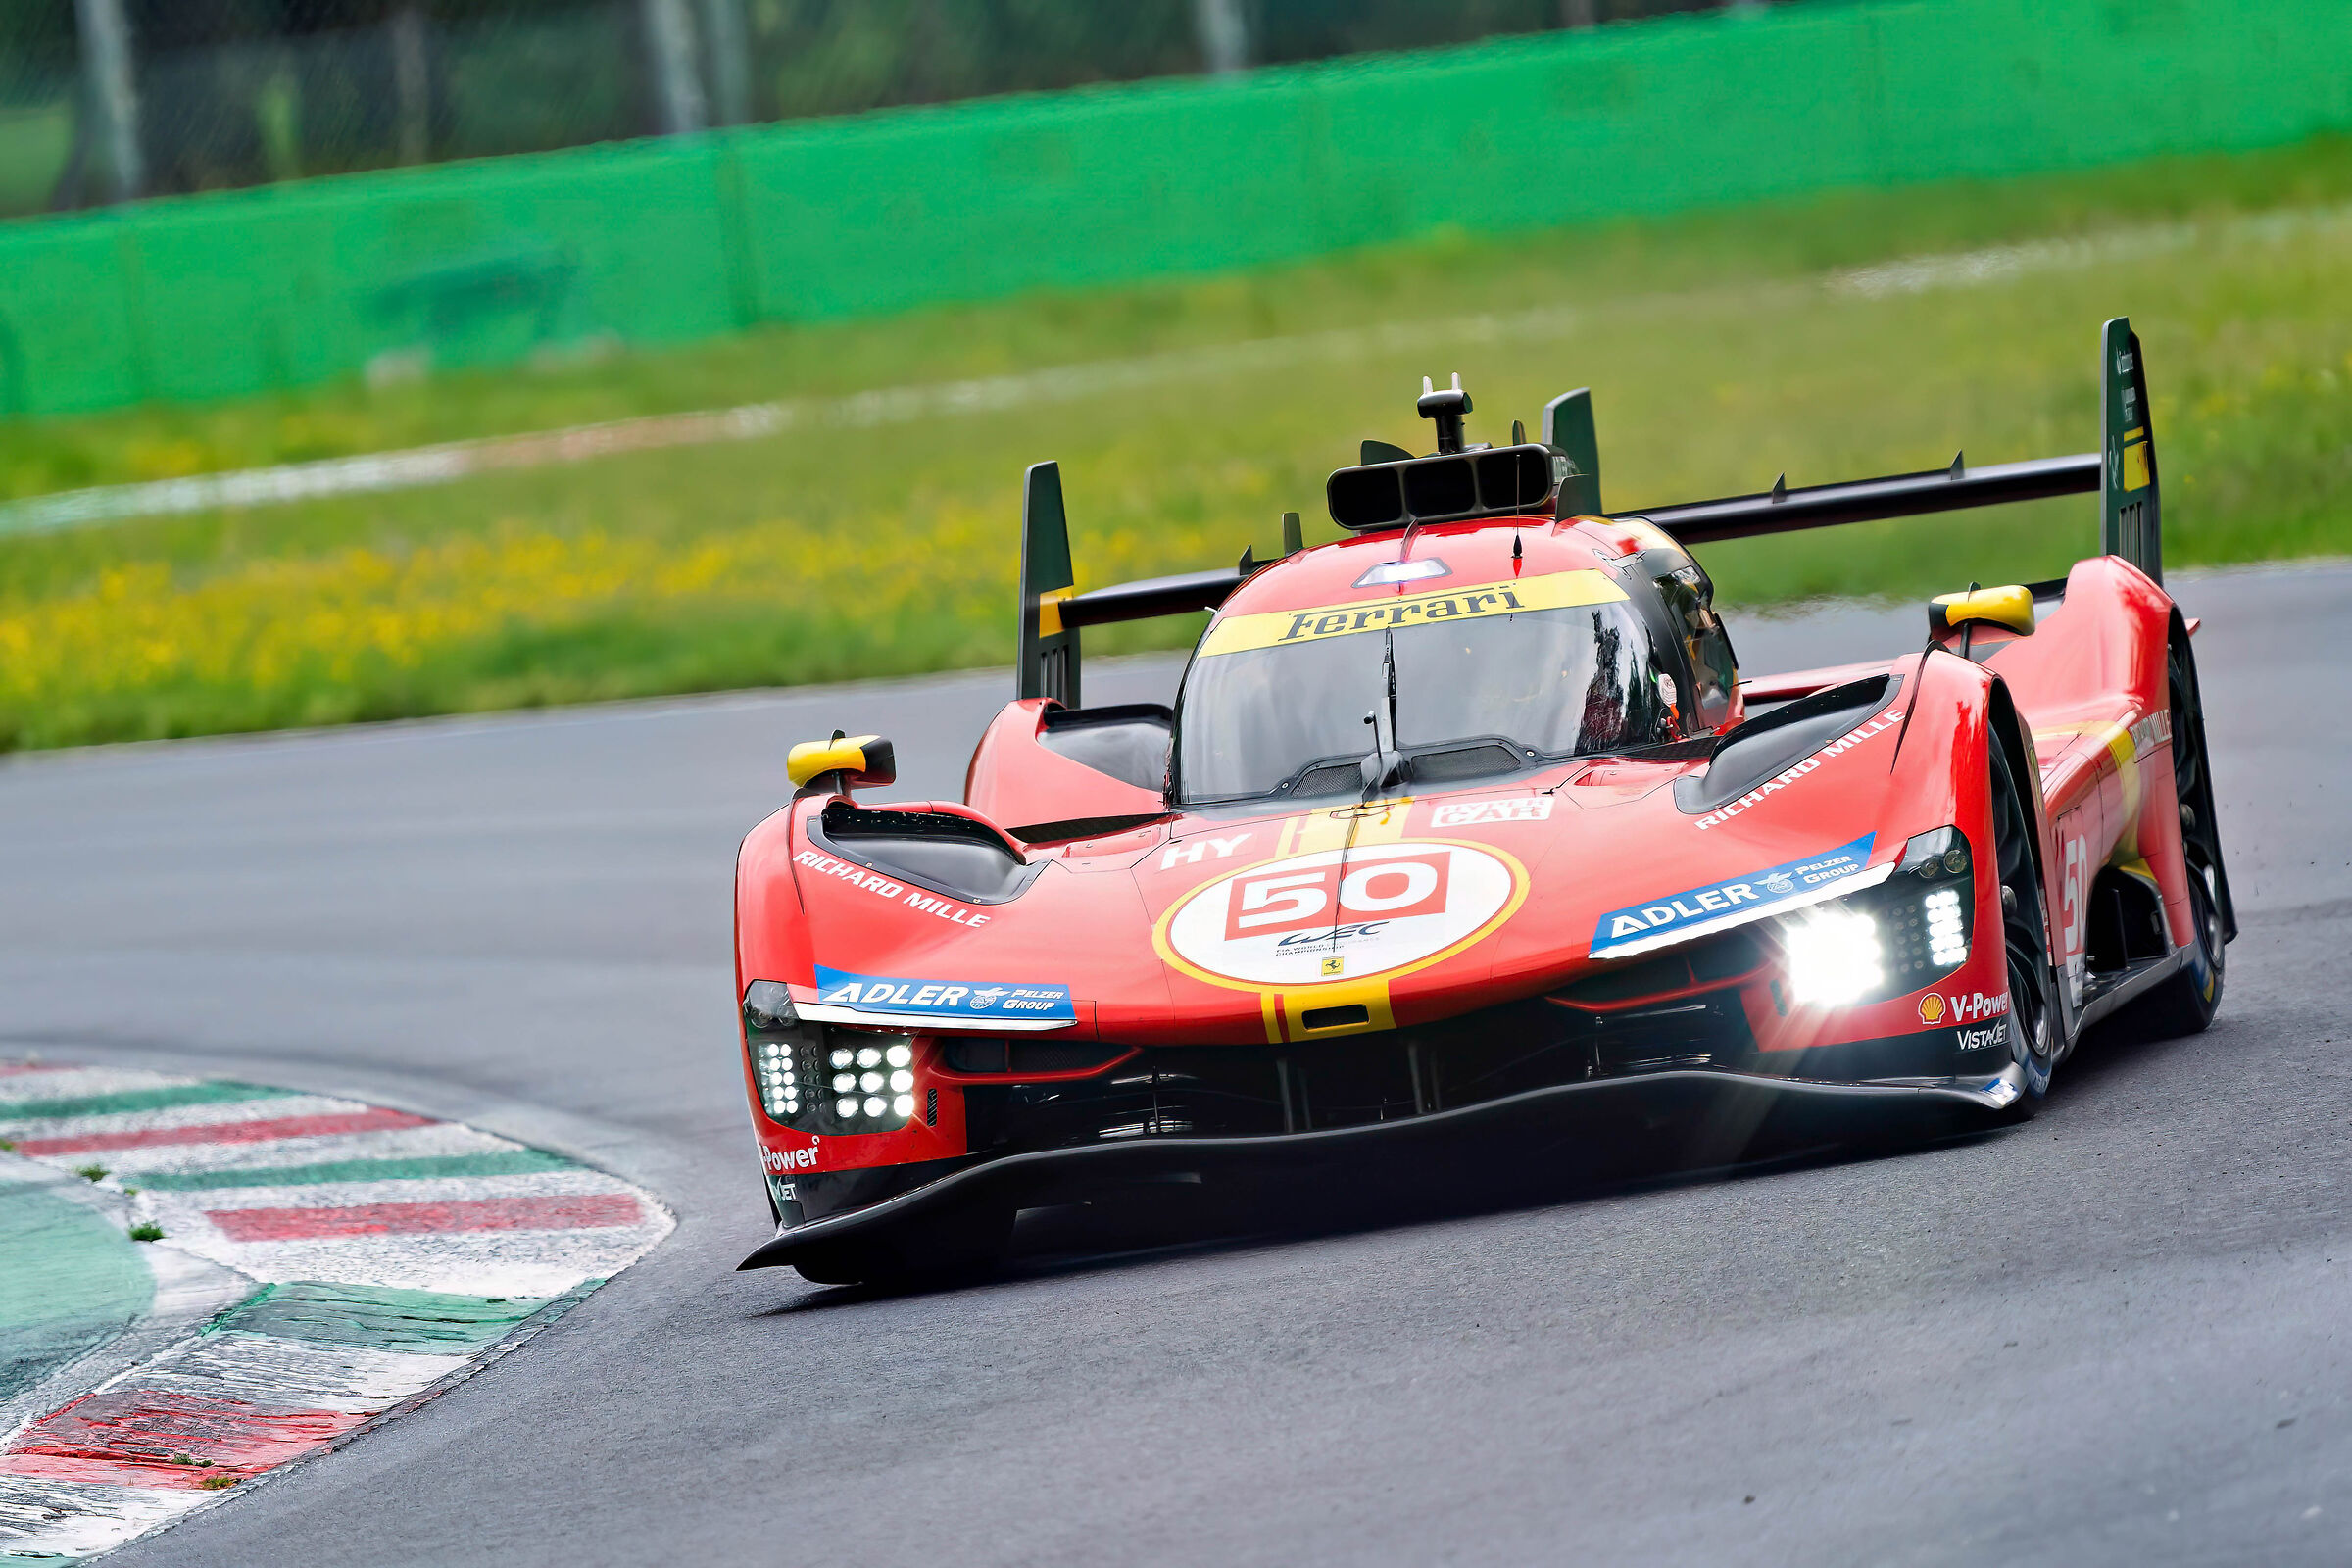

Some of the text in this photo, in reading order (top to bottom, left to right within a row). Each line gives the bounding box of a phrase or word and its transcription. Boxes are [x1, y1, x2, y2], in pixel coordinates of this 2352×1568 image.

[1278, 584, 1525, 642] Ferrari
[1694, 709, 1906, 831] RICHARD MILLE
[1439, 806, 1543, 824] CAR
[1159, 833, 1252, 871] HY
[1795, 855, 1854, 875] PELZER
[793, 850, 991, 928] RICHARD MILLE
[1803, 863, 1860, 885] GROUP
[1238, 861, 1438, 929] 50
[1611, 883, 1761, 939] ADLER
[822, 983, 970, 1006] ADLER
[1002, 999, 1056, 1011] GROUP
[1012, 988, 1065, 1000] PELZER
